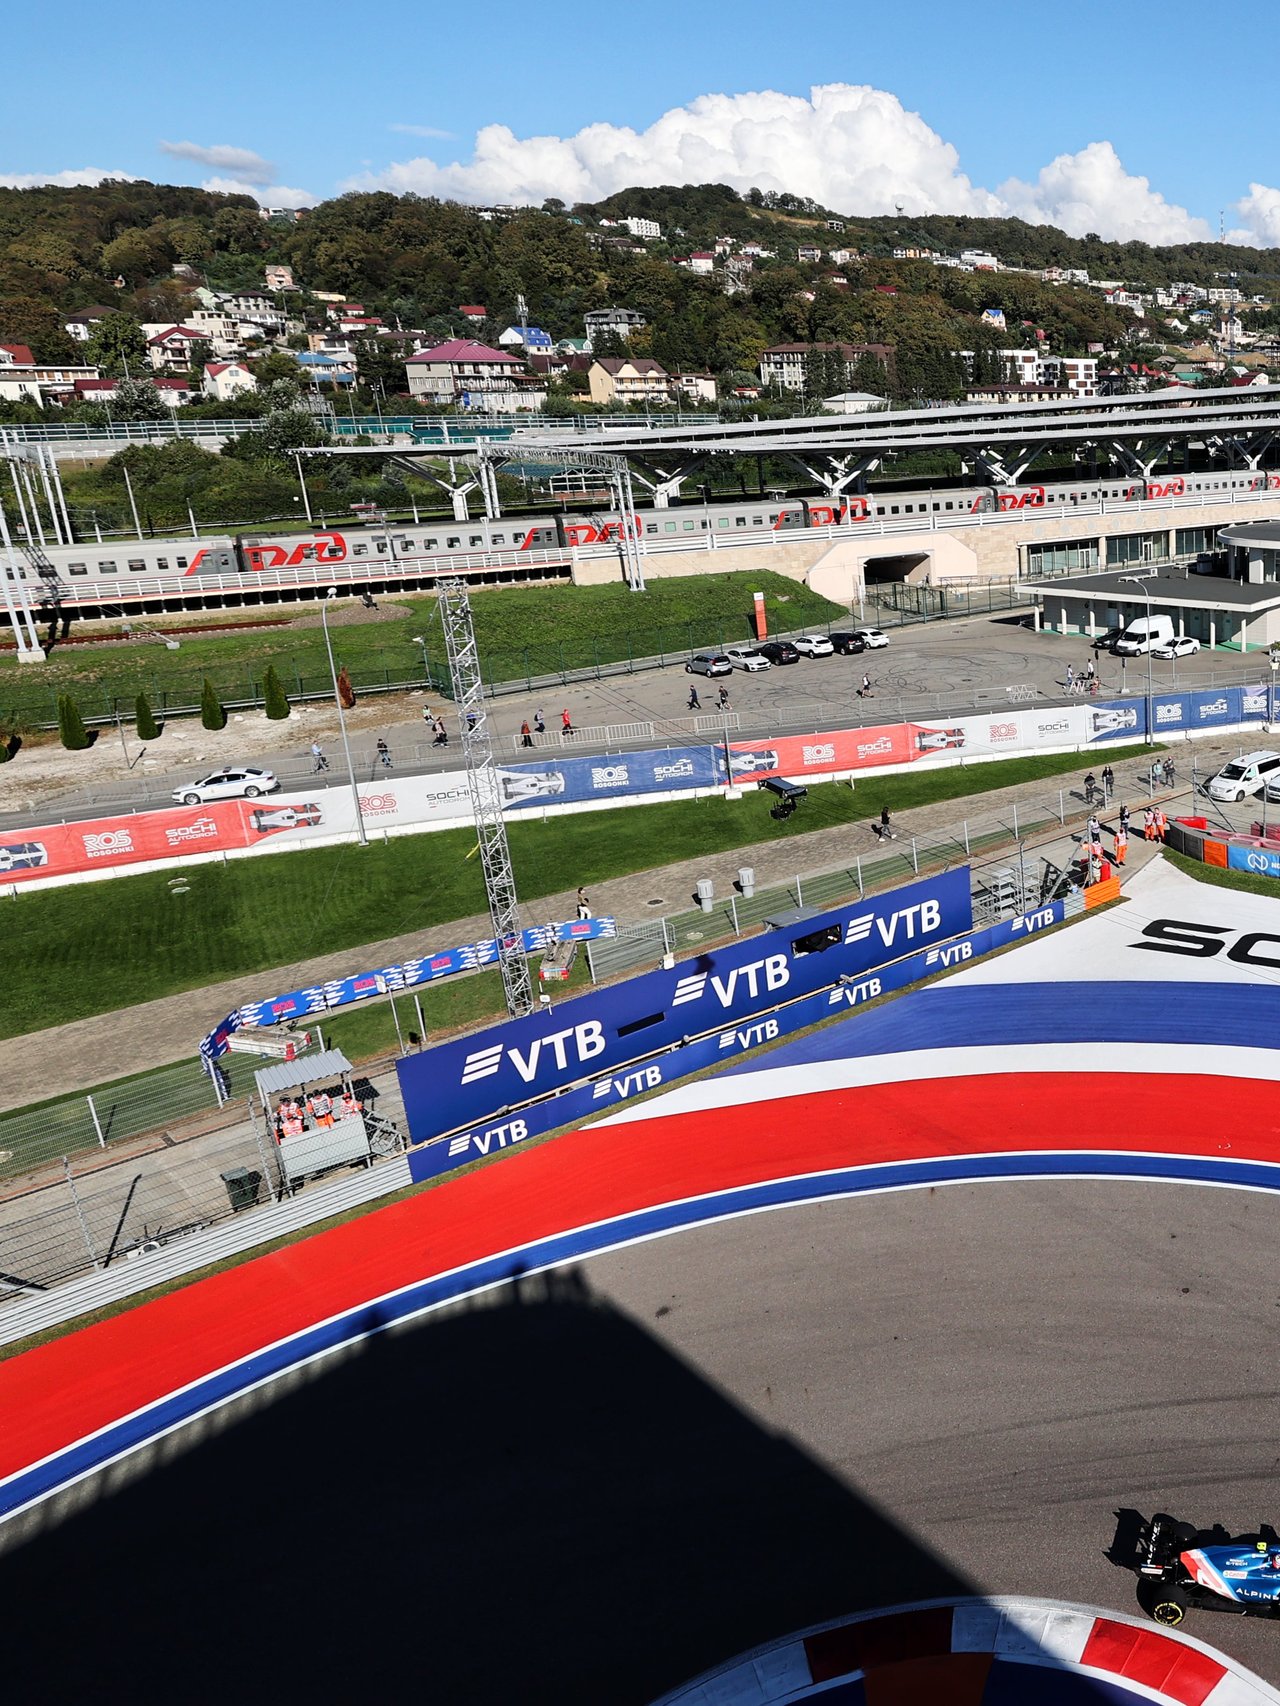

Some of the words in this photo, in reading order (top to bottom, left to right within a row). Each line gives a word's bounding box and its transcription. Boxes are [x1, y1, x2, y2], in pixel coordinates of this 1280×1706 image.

[1157, 703, 1182, 719] ROS
[1200, 703, 1228, 712] SOCHI
[989, 723, 1017, 738] ROS
[1038, 723, 1069, 732] SOCHI
[802, 743, 834, 760] ROS
[857, 741, 892, 752] SOCHI
[592, 765, 628, 783] ROS
[653, 763, 693, 775] SOCHI
[358, 793, 397, 812] ROS
[426, 789, 470, 802] SOCHI
[360, 809, 398, 817] OSGONKI
[165, 823, 217, 838] SOCHI
[167, 831, 218, 843] AUTODROM
[82, 829, 132, 853] ROS
[87, 845, 135, 858] ROSGONKI
[876, 899, 941, 947] VTB
[1024, 908, 1054, 932] VTB
[939, 941, 973, 967] VTB
[710, 953, 790, 1007] VTB
[847, 978, 881, 1005] VTB
[738, 1019, 779, 1050] VTB
[506, 1019, 606, 1083] VTB
[614, 1065, 662, 1098] VTB
[473, 1119, 528, 1155] VTB
[1236, 1588, 1280, 1600] ALPINE
